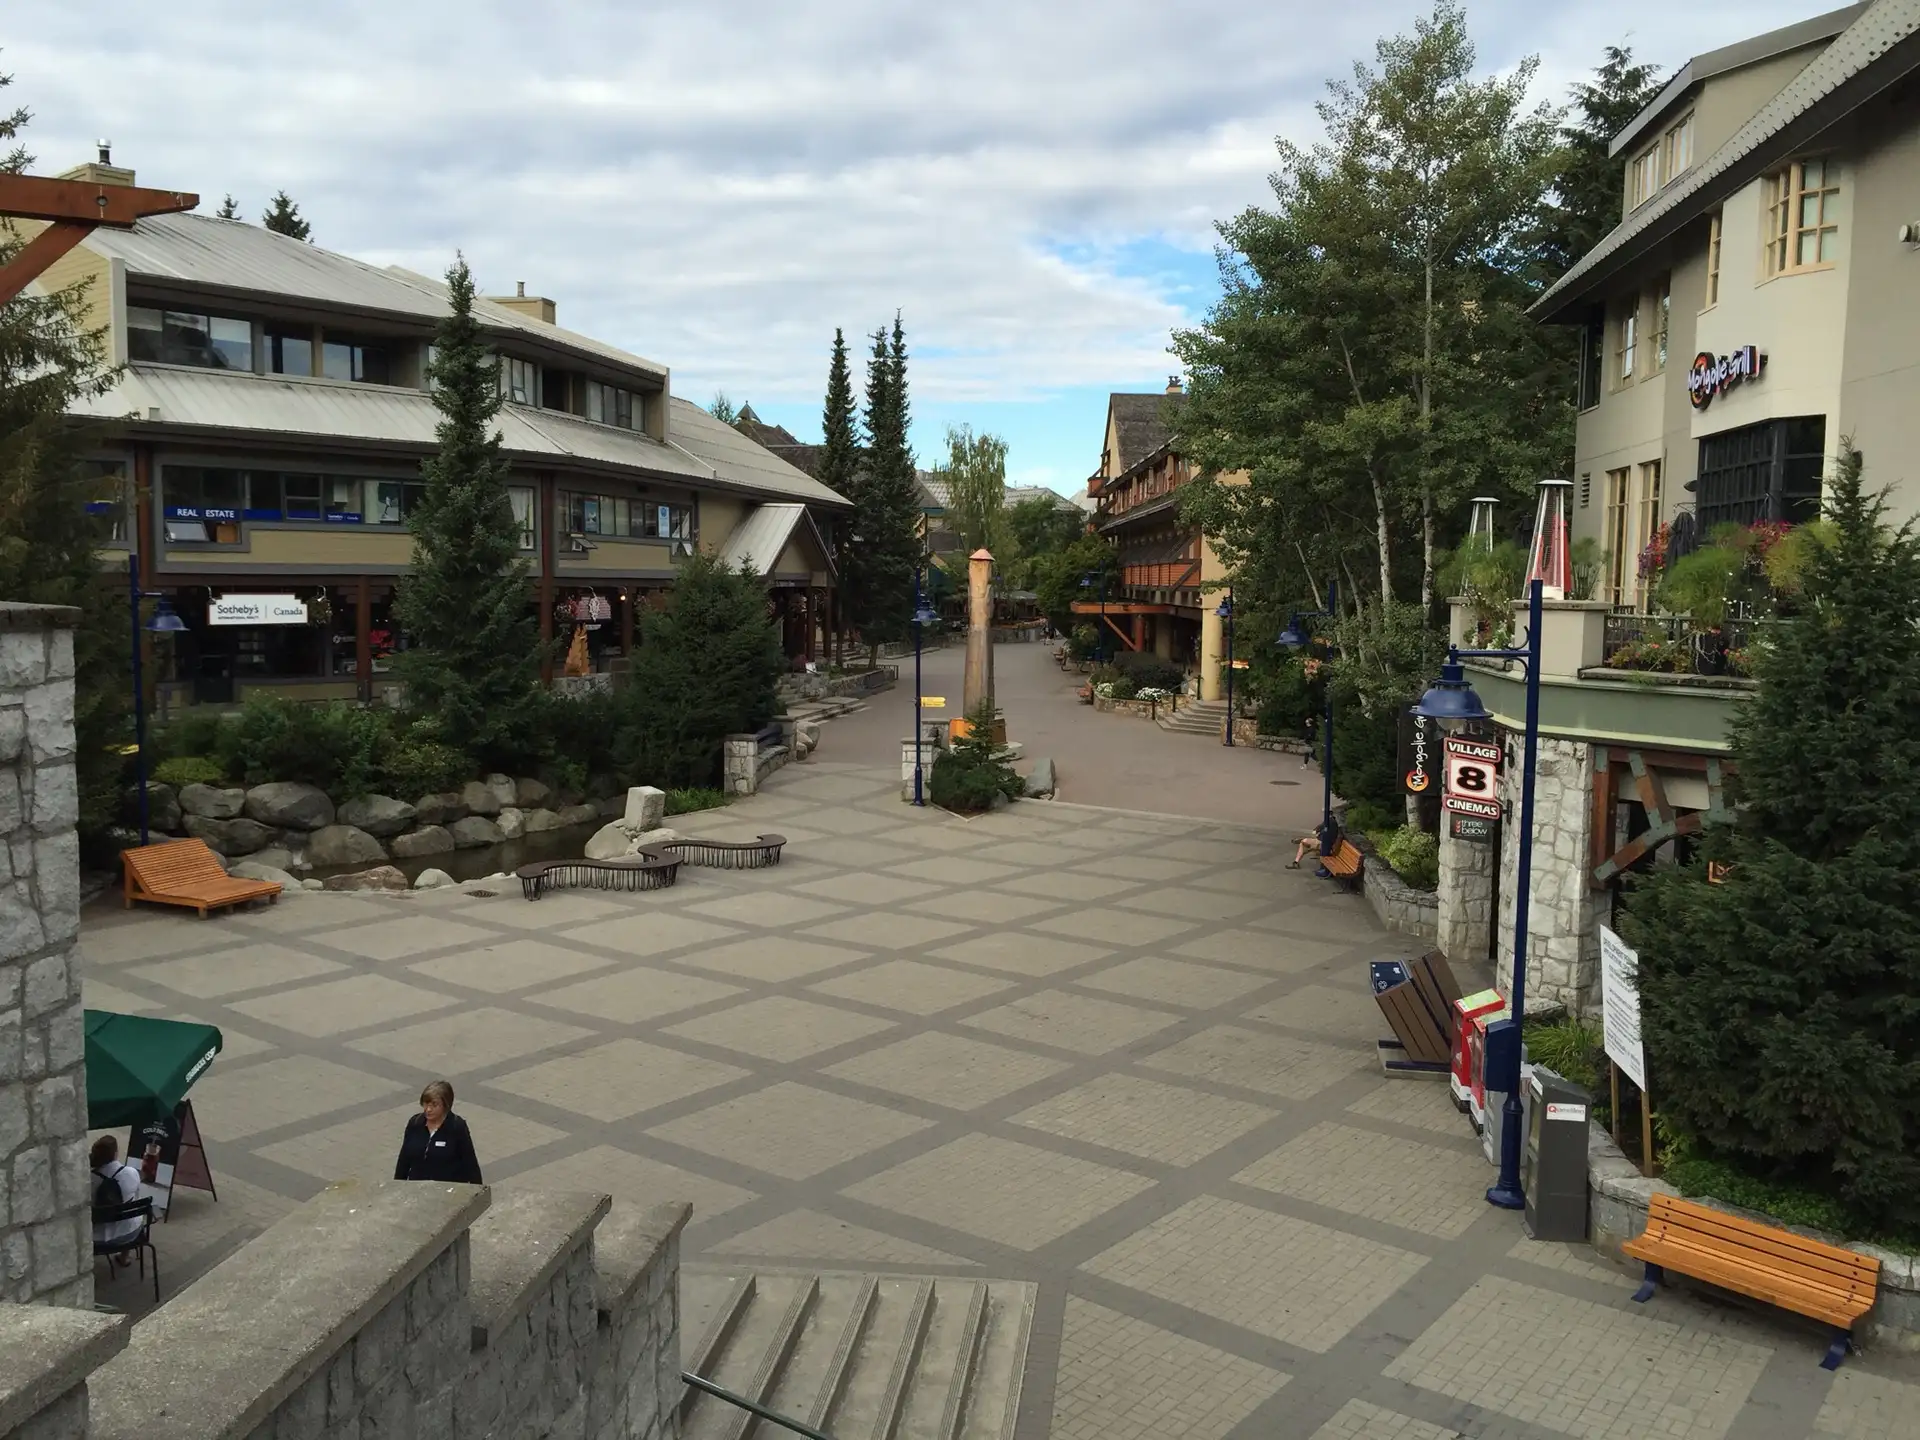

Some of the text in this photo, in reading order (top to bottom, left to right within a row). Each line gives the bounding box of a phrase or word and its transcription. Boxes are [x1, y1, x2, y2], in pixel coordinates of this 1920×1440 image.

[177, 508, 235, 518] REAL ESTATE
[217, 604, 303, 616] Sotheby's Canada
[1448, 742, 1497, 759] VILLAGE
[1410, 731, 1428, 787] Mongolie
[1456, 766, 1487, 791] 8
[1446, 799, 1497, 816] CINEMAS
[1461, 819, 1483, 827] three
[1461, 827, 1488, 835] below
